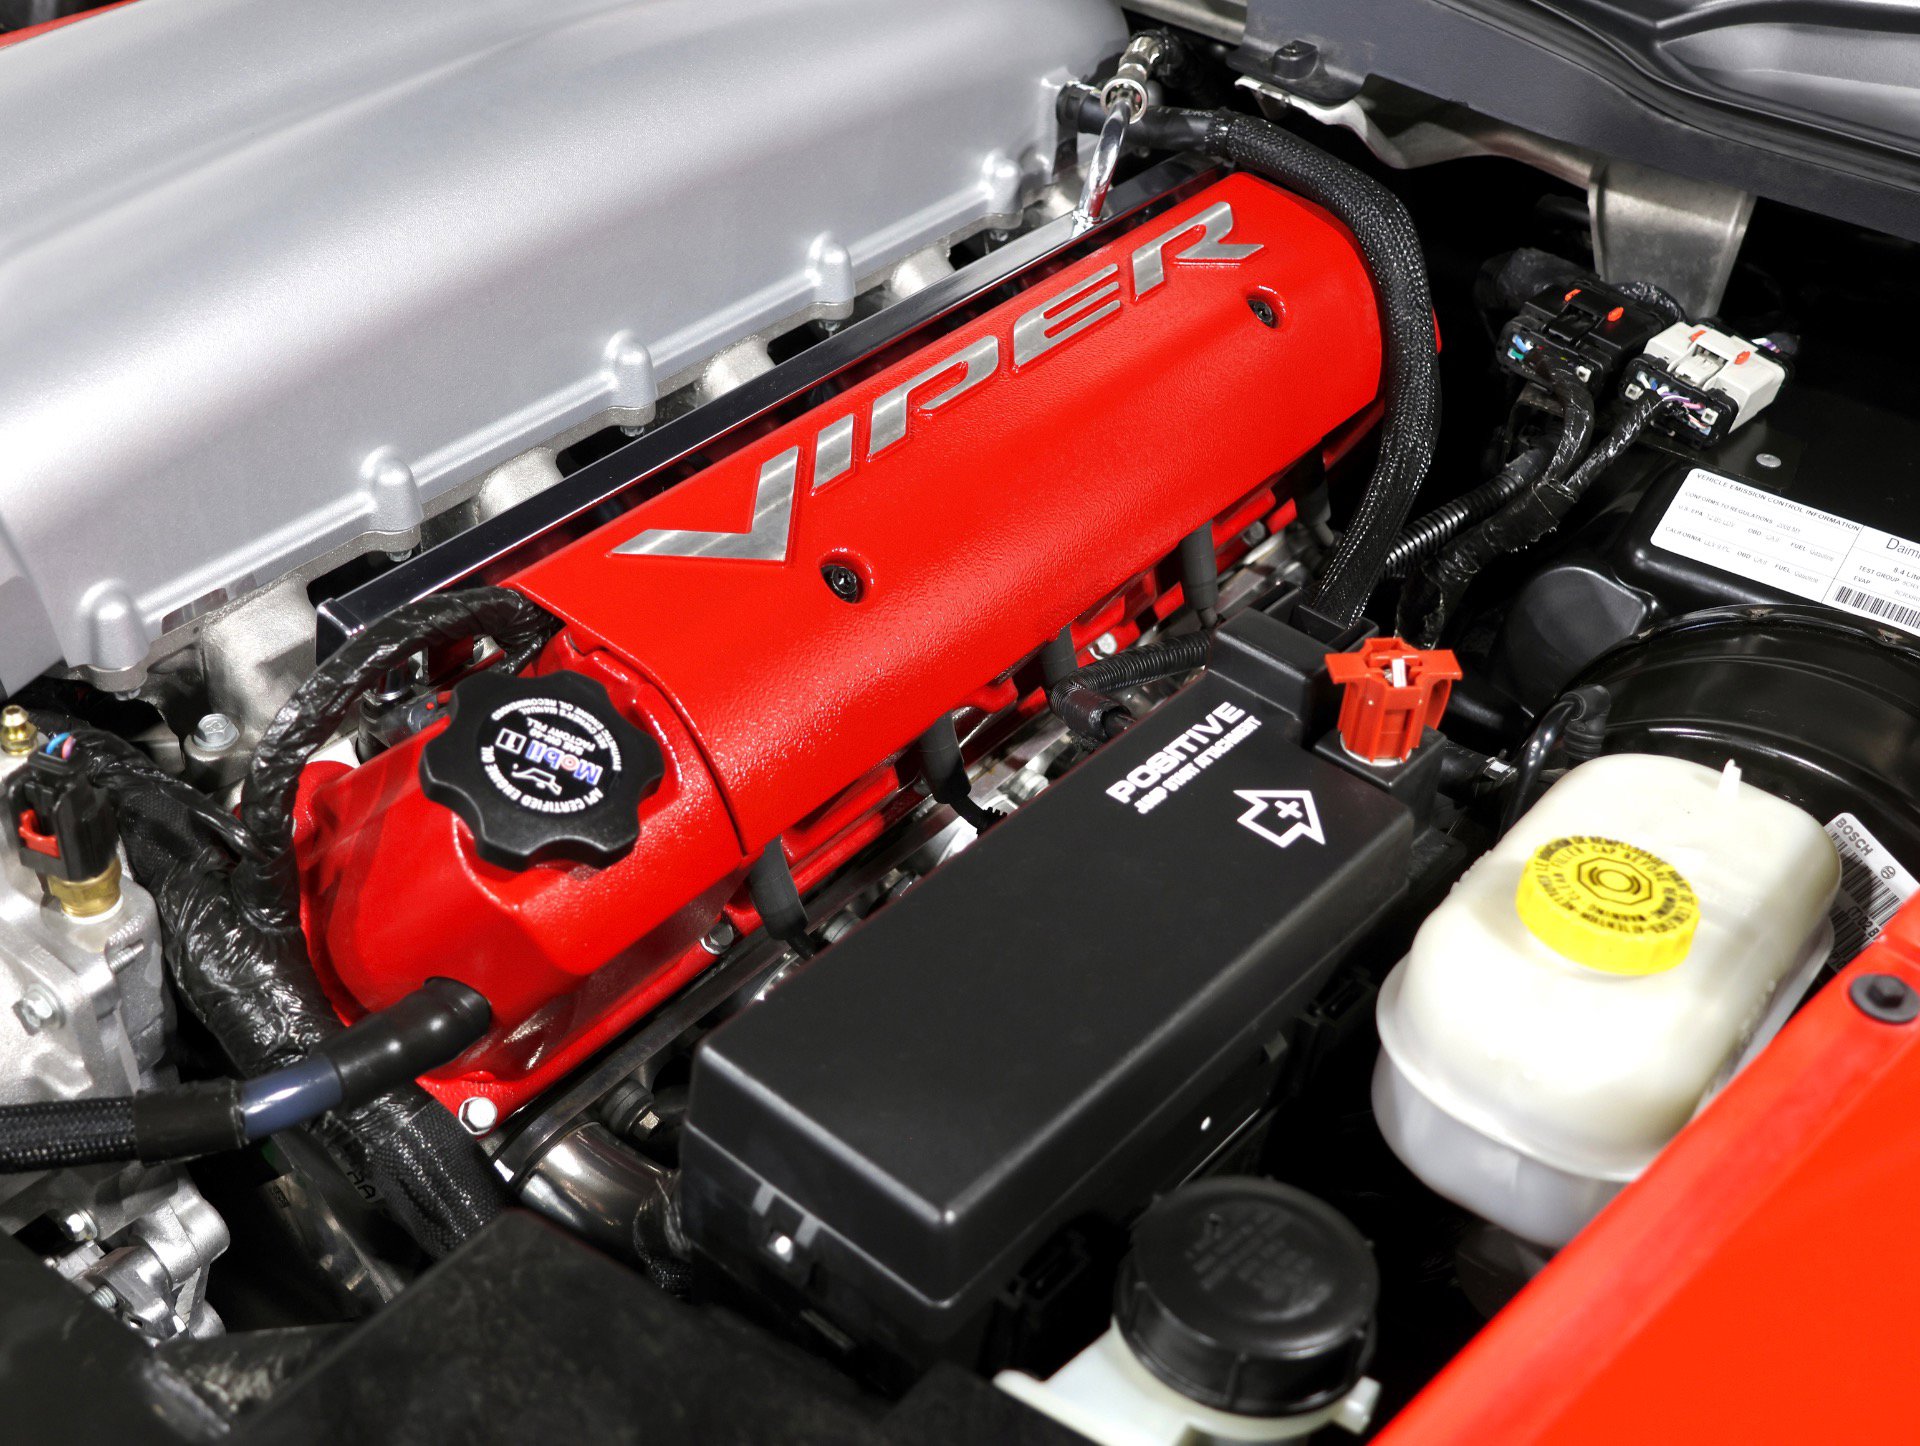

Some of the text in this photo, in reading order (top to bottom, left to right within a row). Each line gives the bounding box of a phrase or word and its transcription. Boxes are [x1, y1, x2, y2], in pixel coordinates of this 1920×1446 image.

[606, 200, 1267, 563] VIPER
[1685, 490, 1719, 507] CONFORMS
[1730, 505, 1773, 525] REGULATIONS
[1697, 472, 1860, 531] VEHICLE EMISSION CONTROL INFORMATION
[1665, 526, 1702, 543] CALIFORNIA
[1737, 550, 1751, 560] OBD
[1775, 563, 1791, 574] FUEL
[1690, 509, 1703, 518] EPA
[1748, 527, 1762, 537] OBD
[1790, 541, 1807, 552] FUEL
[1853, 575, 1871, 585] EVAP
[1859, 565, 1900, 583] TEST GROUP
[490, 697, 622, 772] SYNTHETIC ENGINE OIL RECOMMENDED
[518, 706, 609, 750] SEE OWNER'S MANUAL
[526, 717, 596, 752] FACTORY FILL
[562, 740, 584, 756] SAE
[1193, 714, 1263, 769] ATTACHMENT
[525, 739, 603, 786] Mobil
[1105, 701, 1246, 804] POSITIVE
[480, 745, 604, 814] API CERTIFIED ENGINE OIL
[1591, 845, 1616, 855] CAP
[1835, 817, 1873, 856] BOSCH
